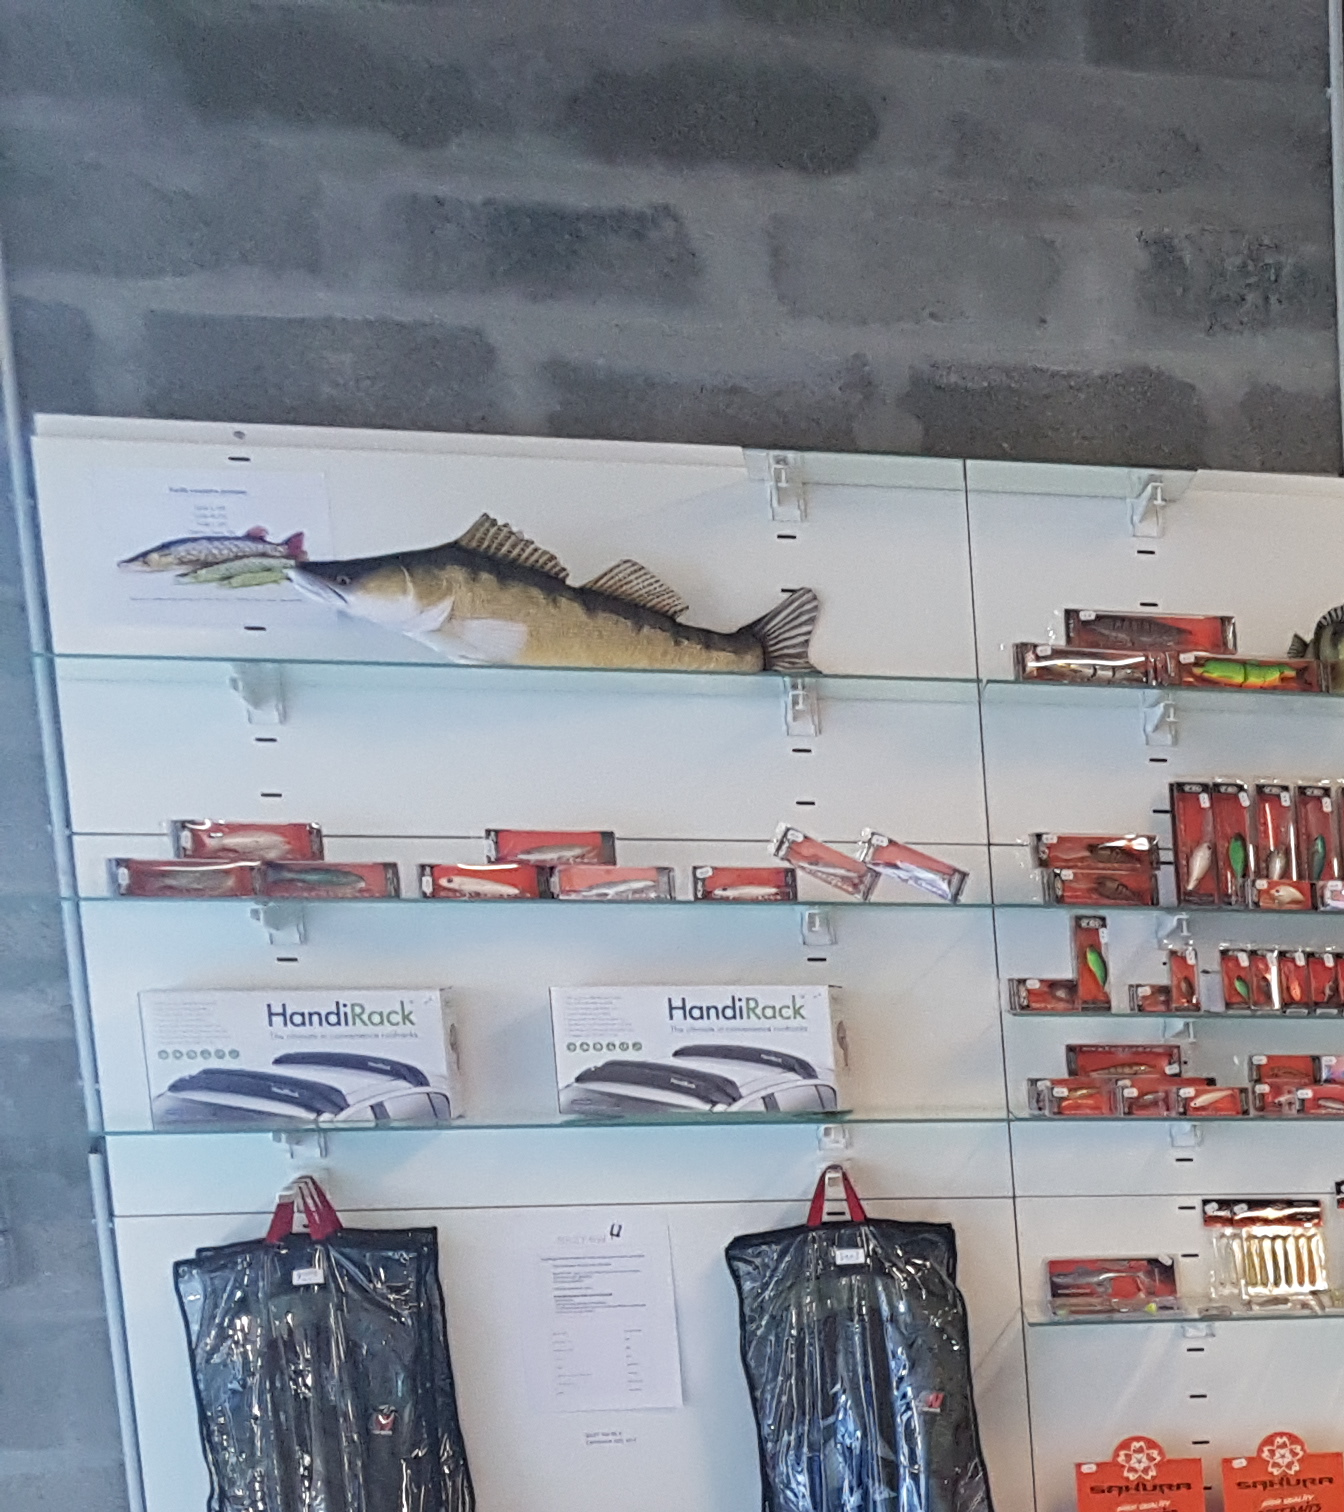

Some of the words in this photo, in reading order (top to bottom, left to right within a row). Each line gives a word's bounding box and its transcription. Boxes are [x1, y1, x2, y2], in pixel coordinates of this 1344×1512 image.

[266, 1000, 416, 1028] HandiRack
[667, 995, 806, 1021] HandiRack
[1089, 1481, 1192, 1497] SAKURA
[1236, 1475, 1334, 1491] SAKURA
